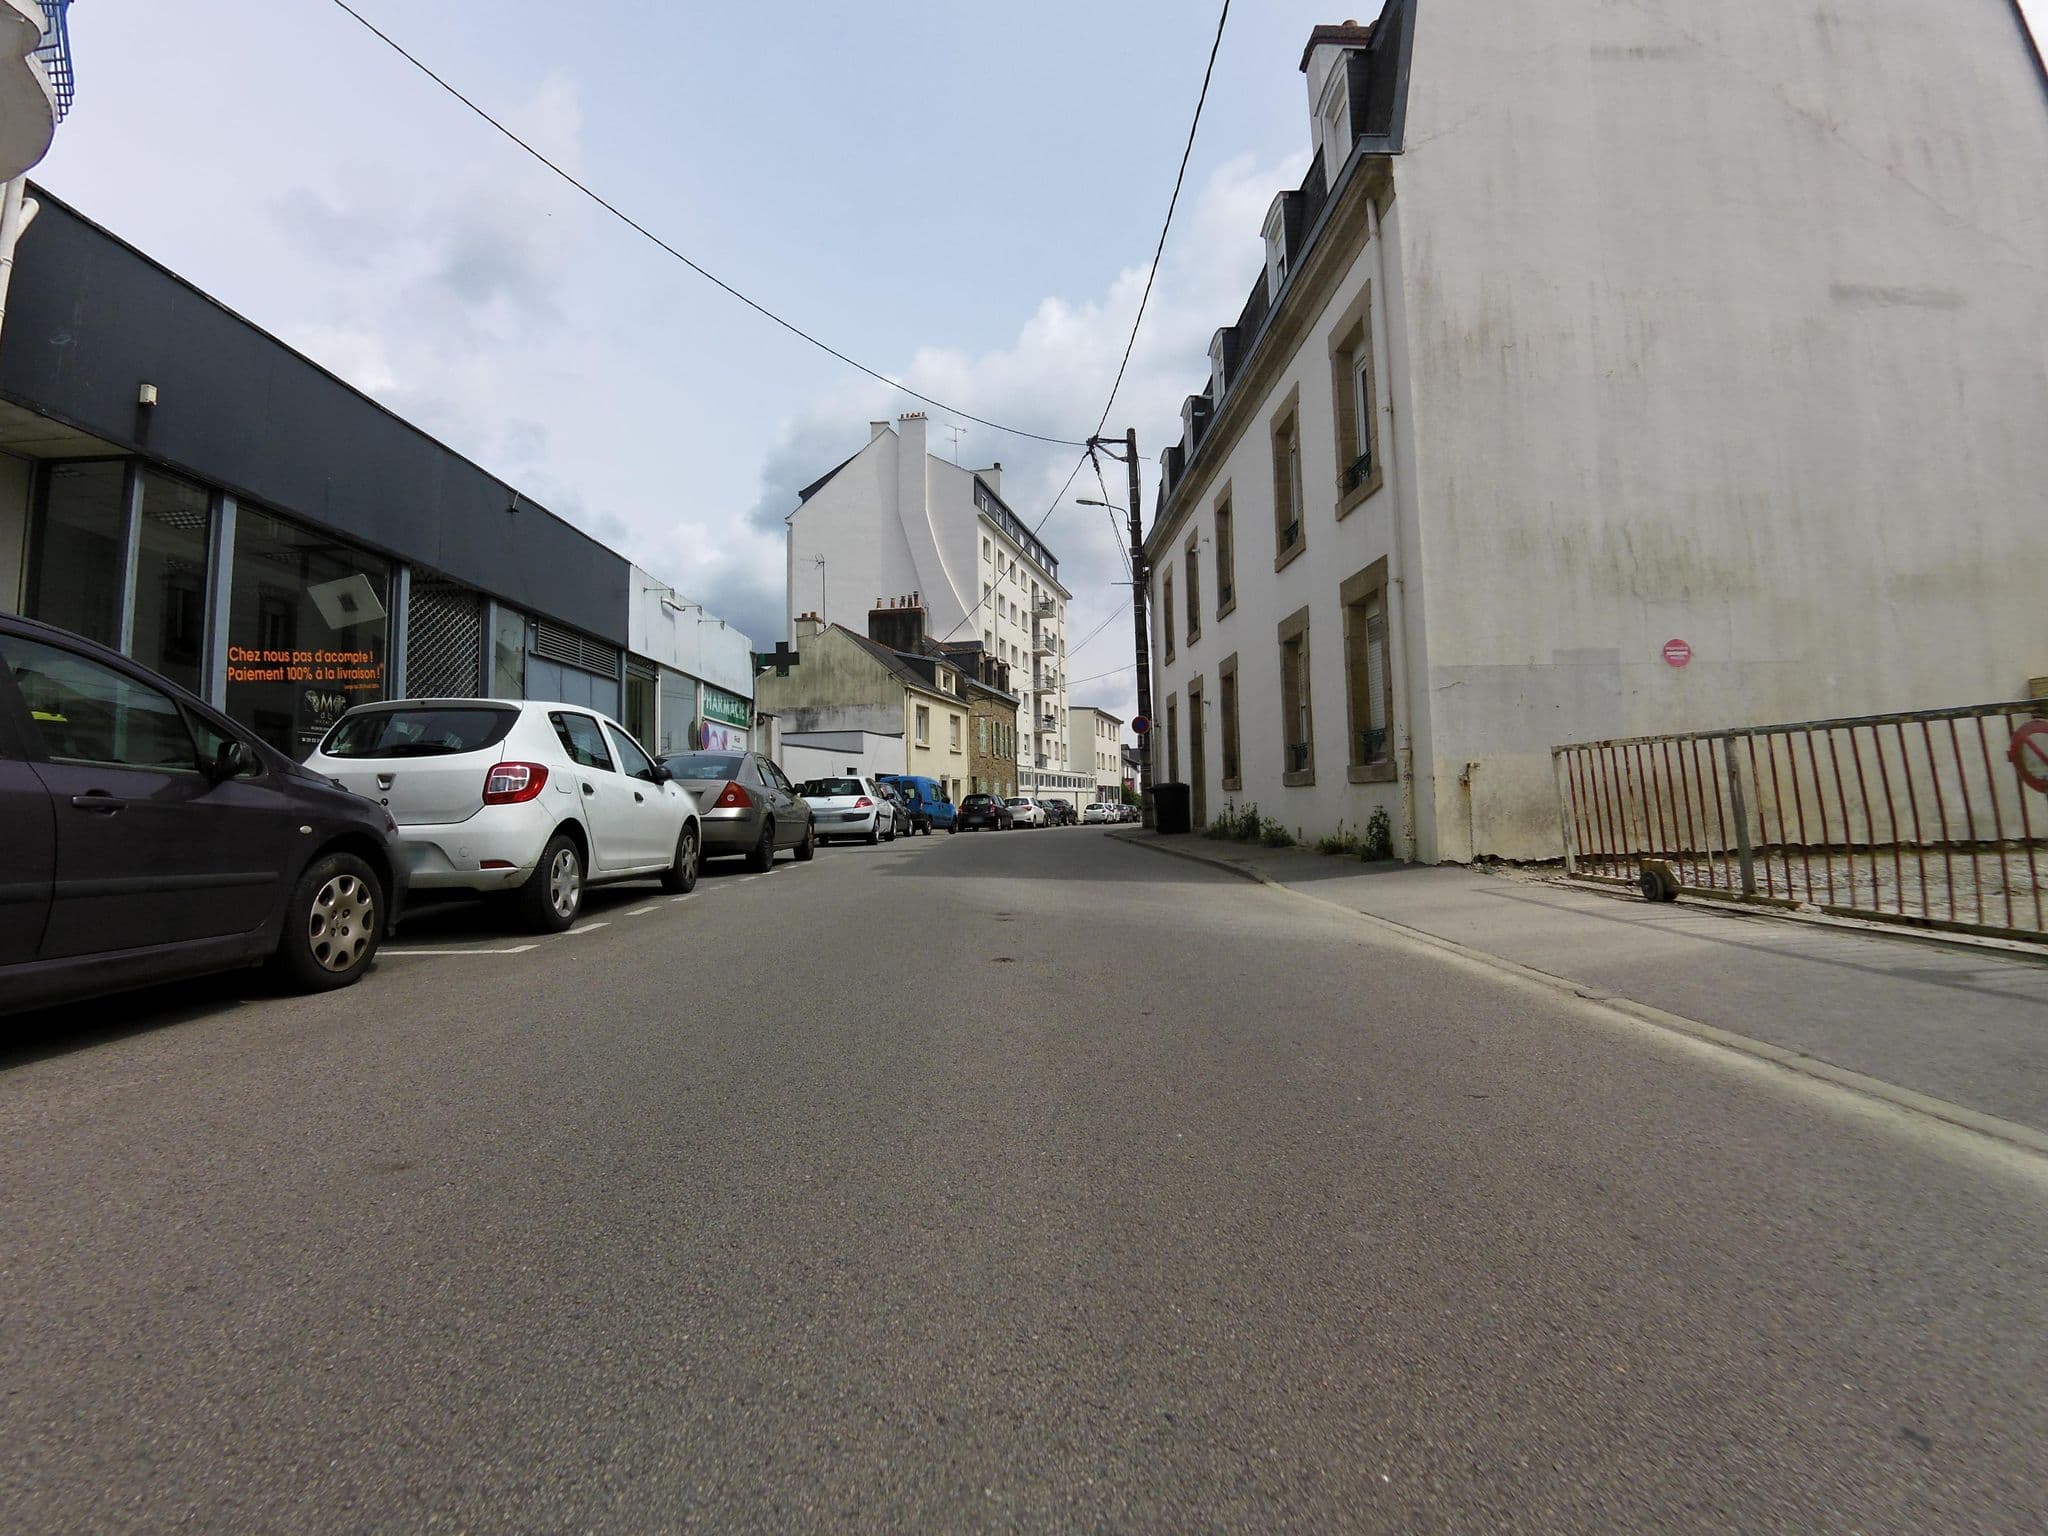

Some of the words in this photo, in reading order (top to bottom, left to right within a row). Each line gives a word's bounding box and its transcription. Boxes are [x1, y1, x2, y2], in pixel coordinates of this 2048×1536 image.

[229, 646, 261, 662] Chez
[263, 650, 290, 662] nous
[293, 651, 313, 665] pas
[315, 649, 369, 665] d'acompte
[228, 666, 284, 681] Paiement
[287, 666, 313, 680] 100%
[316, 667, 322, 680] à
[325, 667, 335, 680] la
[337, 667, 376, 680] livraison
[703, 689, 745, 720] PHARMACIE
